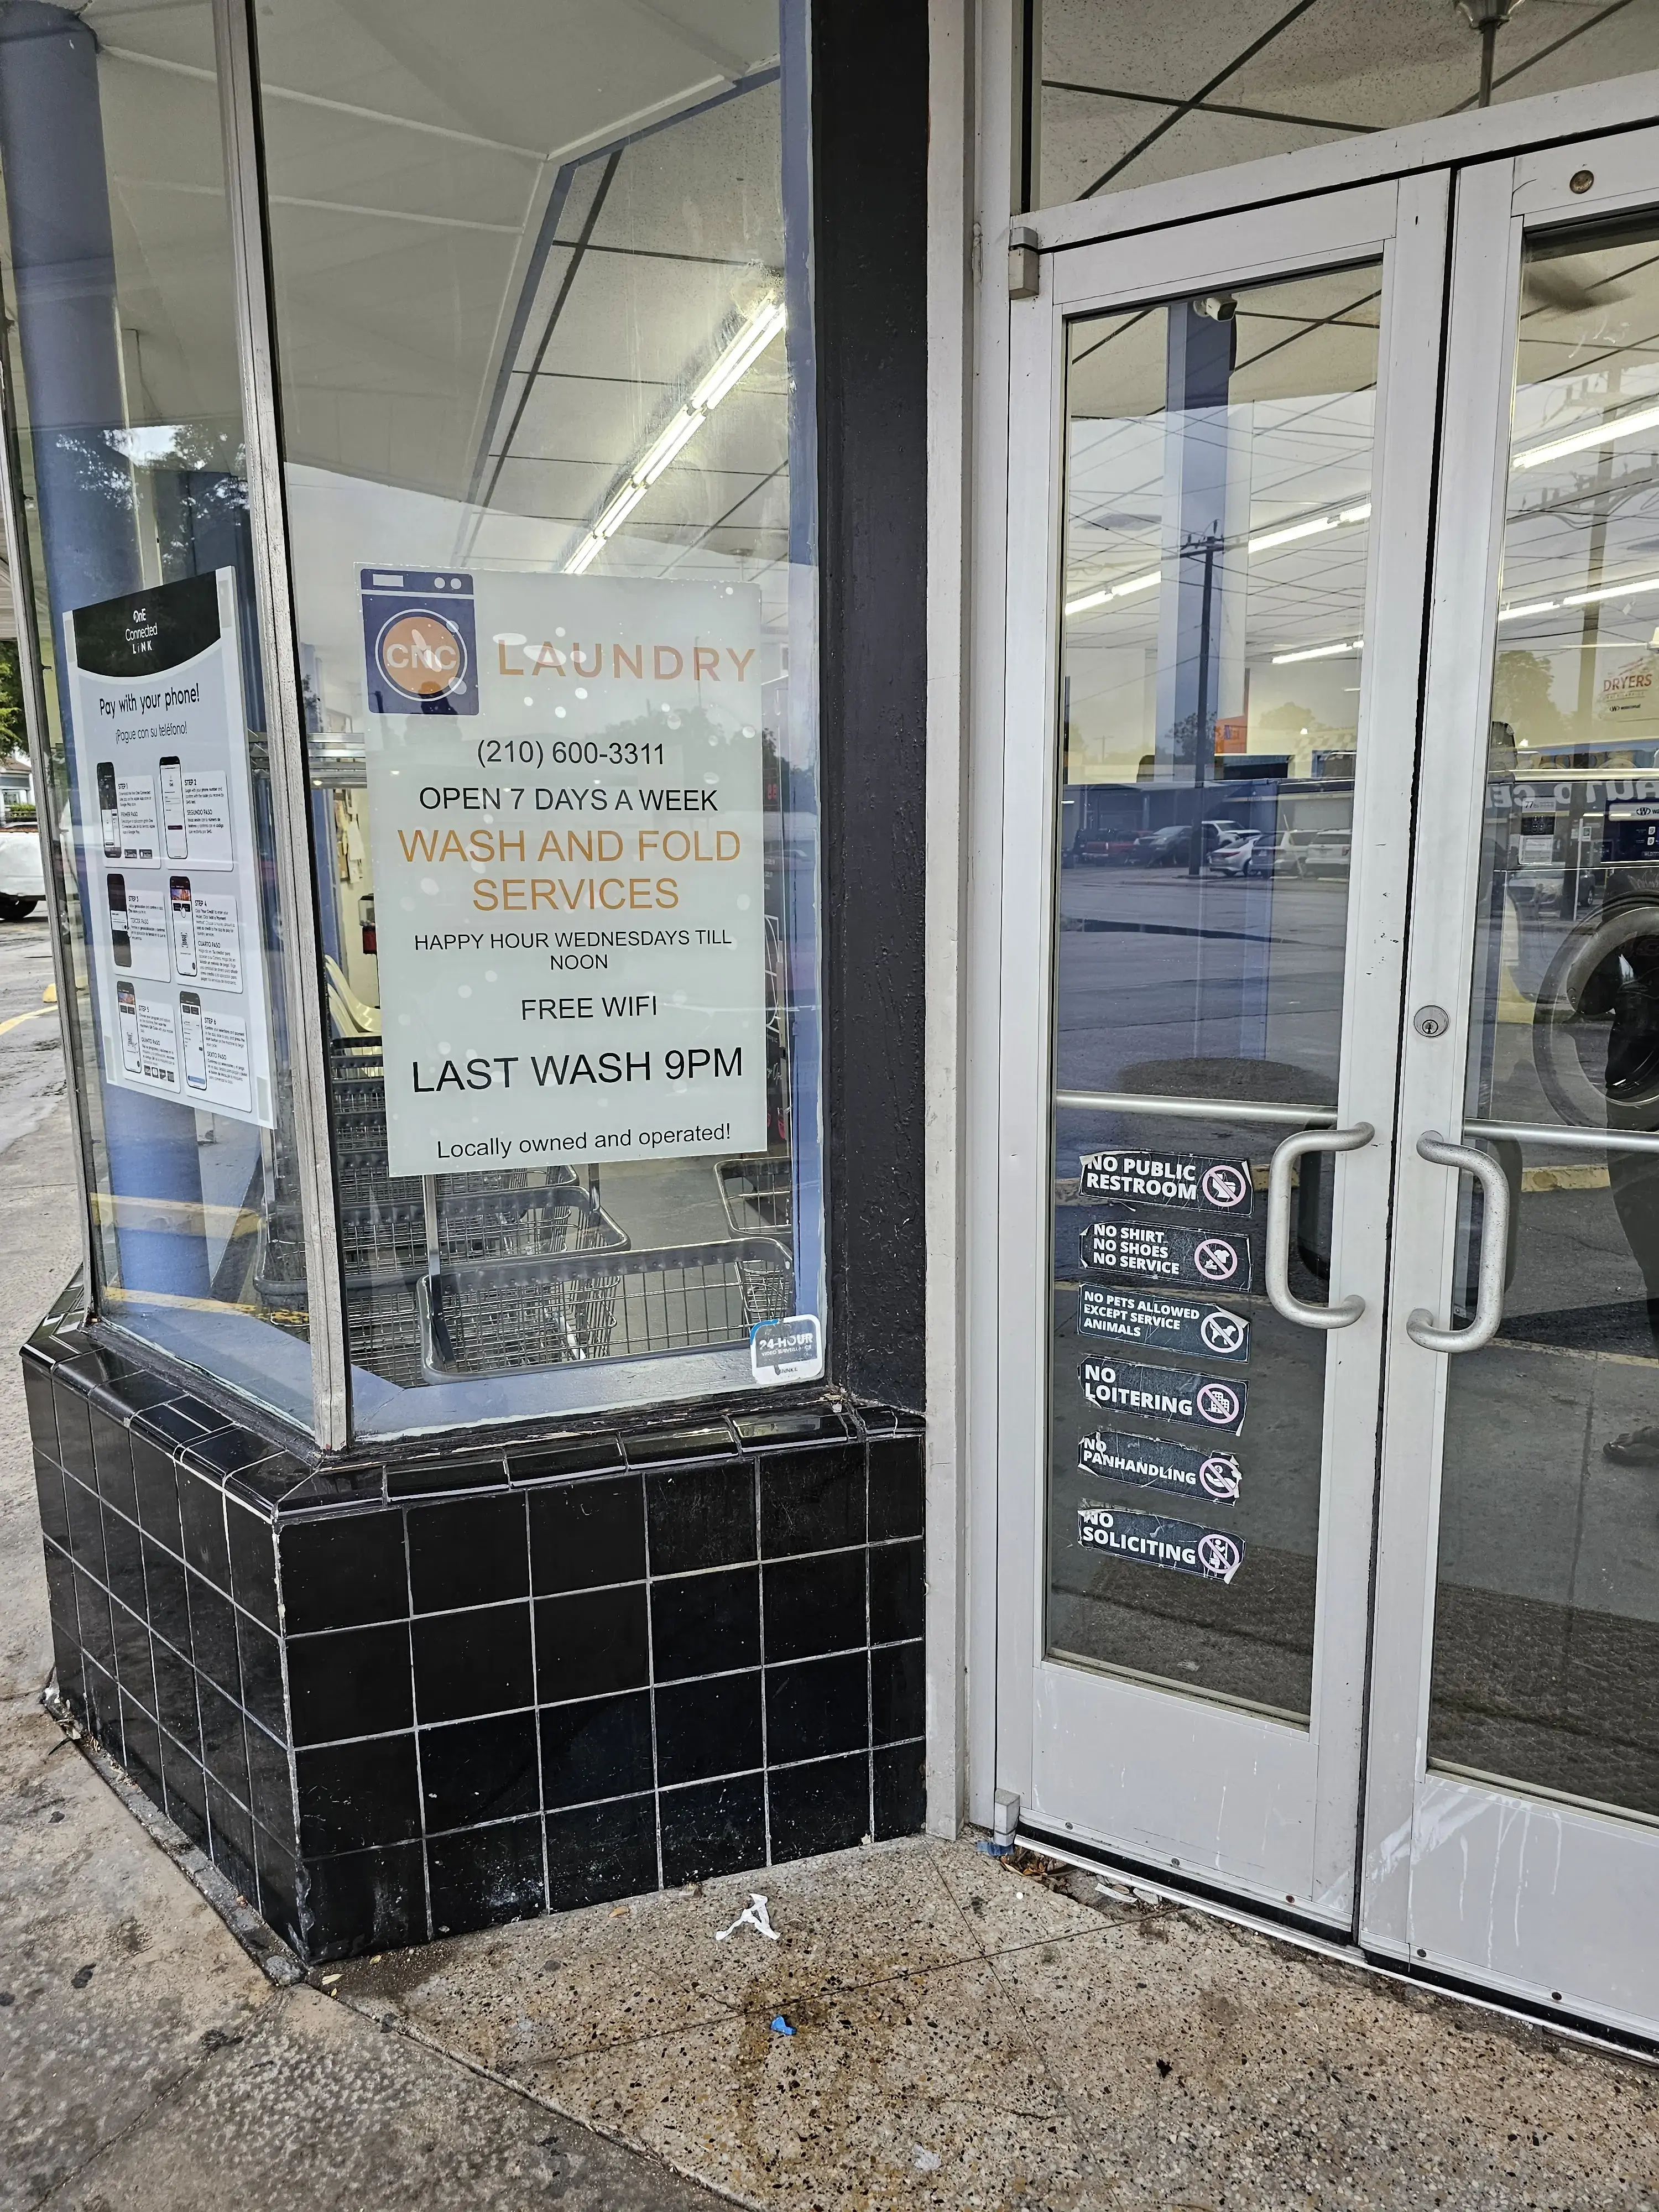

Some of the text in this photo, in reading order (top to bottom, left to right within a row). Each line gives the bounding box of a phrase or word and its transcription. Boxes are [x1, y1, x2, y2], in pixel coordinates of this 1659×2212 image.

[126, 622, 158, 641] Connected
[387, 644, 457, 669] CNC
[498, 639, 755, 682] LAUNDRY
[1603, 674, 1652, 692] DRYERS
[100, 683, 199, 719] Pay with your phone!
[138, 729, 149, 739] con
[151, 728, 157, 737] su
[159, 721, 187, 736] teléfono!
[478, 739, 664, 768] (210) 600-3311
[420, 787, 718, 812] OPEN 7 DAYS A WEEK
[398, 829, 740, 863] WASH AND FOLD
[473, 878, 679, 911] SERVICES
[415, 929, 732, 951] HAPPY HOUR WEDNESDAYS TILL
[550, 954, 608, 971] NOON
[521, 995, 657, 1020] FREE WIFI
[413, 1057, 519, 1093] LAST
[531, 1052, 651, 1086] WASH
[665, 1047, 743, 1080] 9PM
[437, 1123, 731, 1159] Locally owned and operated!
[1087, 1156, 1196, 1181] NO PUBLIC
[1087, 1173, 1197, 1200] RESTROOM
[1094, 1224, 1165, 1243] NO SHIRT
[1093, 1238, 1168, 1258] NO SHOES
[1093, 1252, 1180, 1274] NO SERVICE
[1084, 1291, 1200, 1319] NO PETS ALLOWED
[1084, 1304, 1181, 1329] EXCEPT SERVICE
[1083, 1317, 1141, 1337] ANIMALS
[759, 1333, 813, 1350] 24-HOUR
[1085, 1364, 1116, 1383] NO
[1085, 1383, 1193, 1416] LOITERING
[1084, 1438, 1107, 1453] NO
[1083, 1451, 1196, 1485] PANHANDLING
[1083, 1512, 1114, 1528] NO
[1083, 1526, 1196, 1564] SOLICITING
